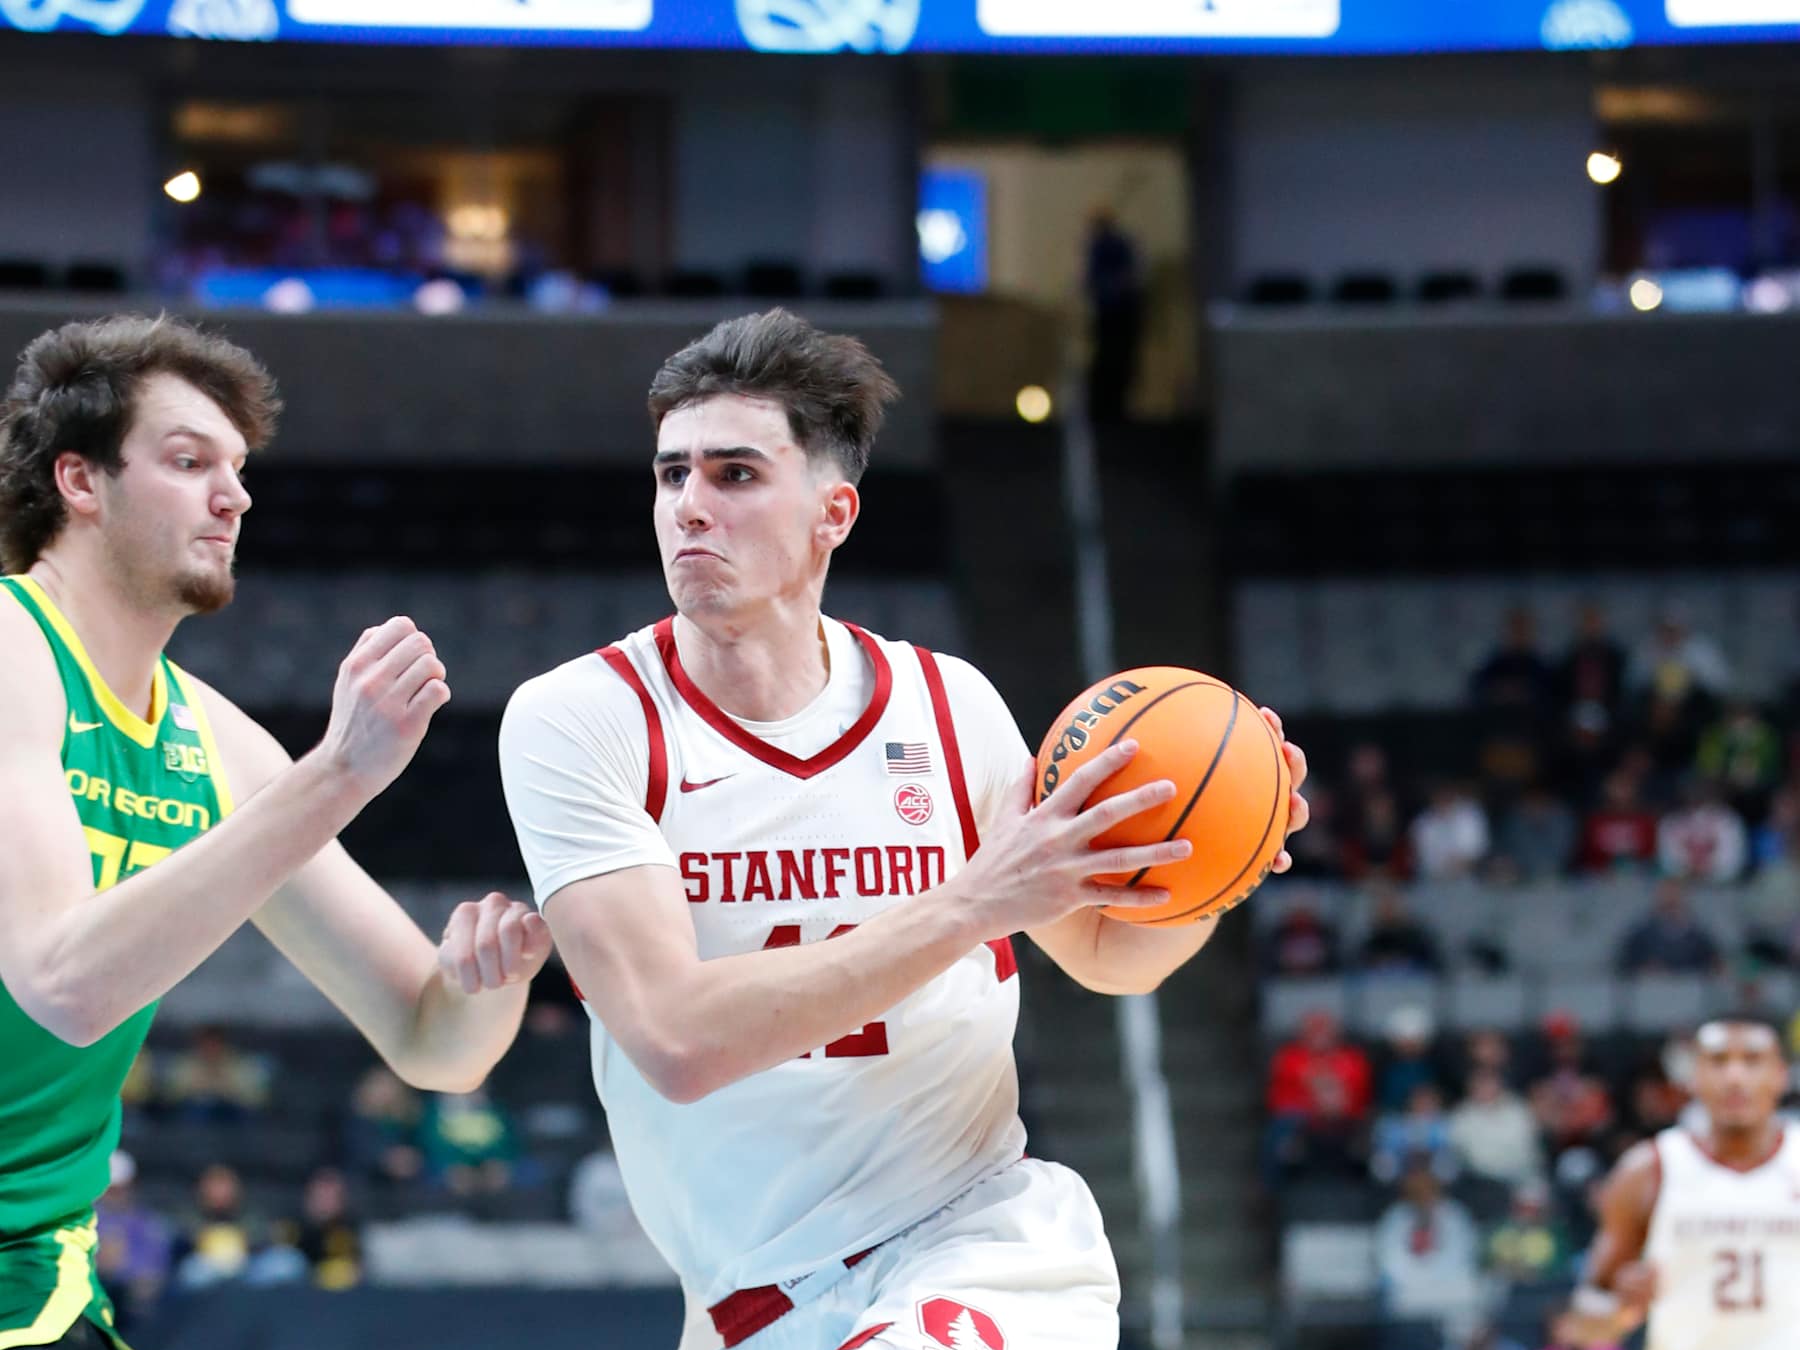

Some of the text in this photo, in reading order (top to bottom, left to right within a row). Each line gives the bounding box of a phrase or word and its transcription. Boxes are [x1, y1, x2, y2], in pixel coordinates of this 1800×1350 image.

[64, 768, 210, 832] OREGON
[900, 796, 930, 809] ACC
[679, 845, 945, 903] STANFORD
[1712, 1247, 1765, 1314] 21
